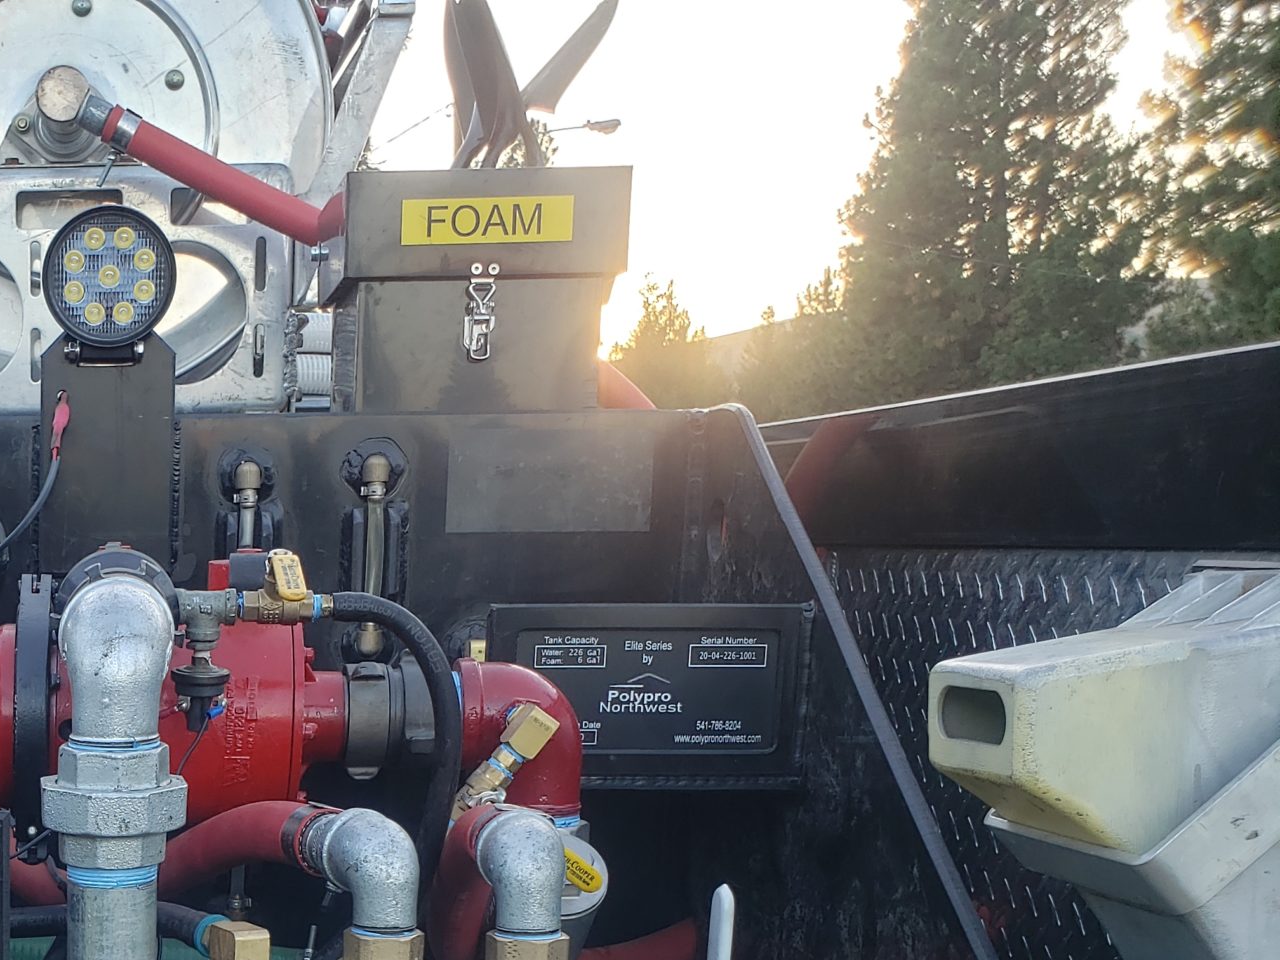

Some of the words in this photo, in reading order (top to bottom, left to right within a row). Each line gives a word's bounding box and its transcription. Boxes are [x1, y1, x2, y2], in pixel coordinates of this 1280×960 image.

[426, 203, 542, 238] FOAM
[544, 636, 563, 644] Tank
[564, 636, 599, 645] Capacity
[624, 640, 644, 651] Elite
[645, 640, 673, 651] Series
[701, 636, 724, 645] Serial
[725, 636, 757, 645] Number
[541, 648, 564, 656] Water:
[568, 648, 583, 656] 226
[699, 651, 756, 660] 20-04-226-1001
[541, 657, 564, 665] Foam:
[578, 656, 583, 664] 6
[586, 656, 601, 664] Gal
[642, 653, 653, 665] by
[608, 690, 671, 705] Polypro
[599, 701, 683, 713] Northwest
[582, 721, 601, 729] Date
[696, 720, 741, 731] 541-786-8204
[674, 733, 762, 745] www.polypronorthwest.com
